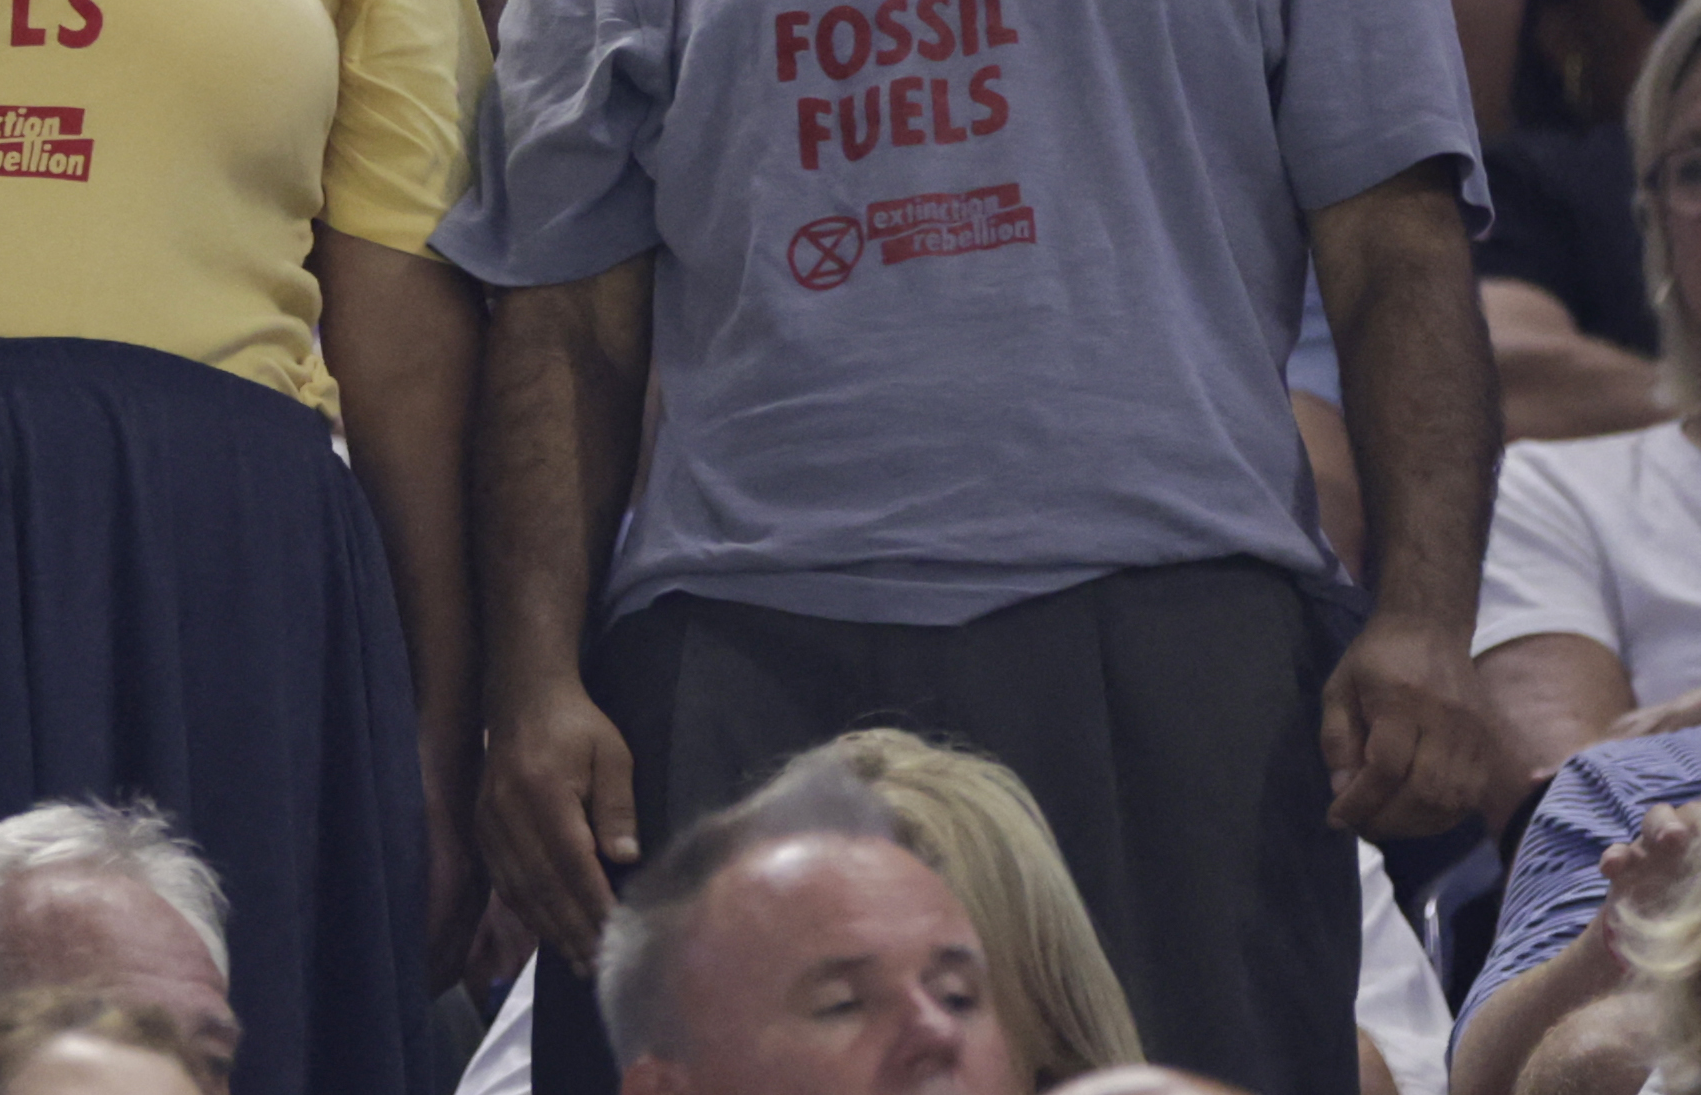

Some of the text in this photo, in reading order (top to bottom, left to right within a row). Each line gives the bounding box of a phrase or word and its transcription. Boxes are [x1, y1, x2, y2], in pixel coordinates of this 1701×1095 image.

[797, 64, 1009, 170] FUELS
[872, 194, 1000, 230] extinction
[912, 216, 1031, 254] rebellion
